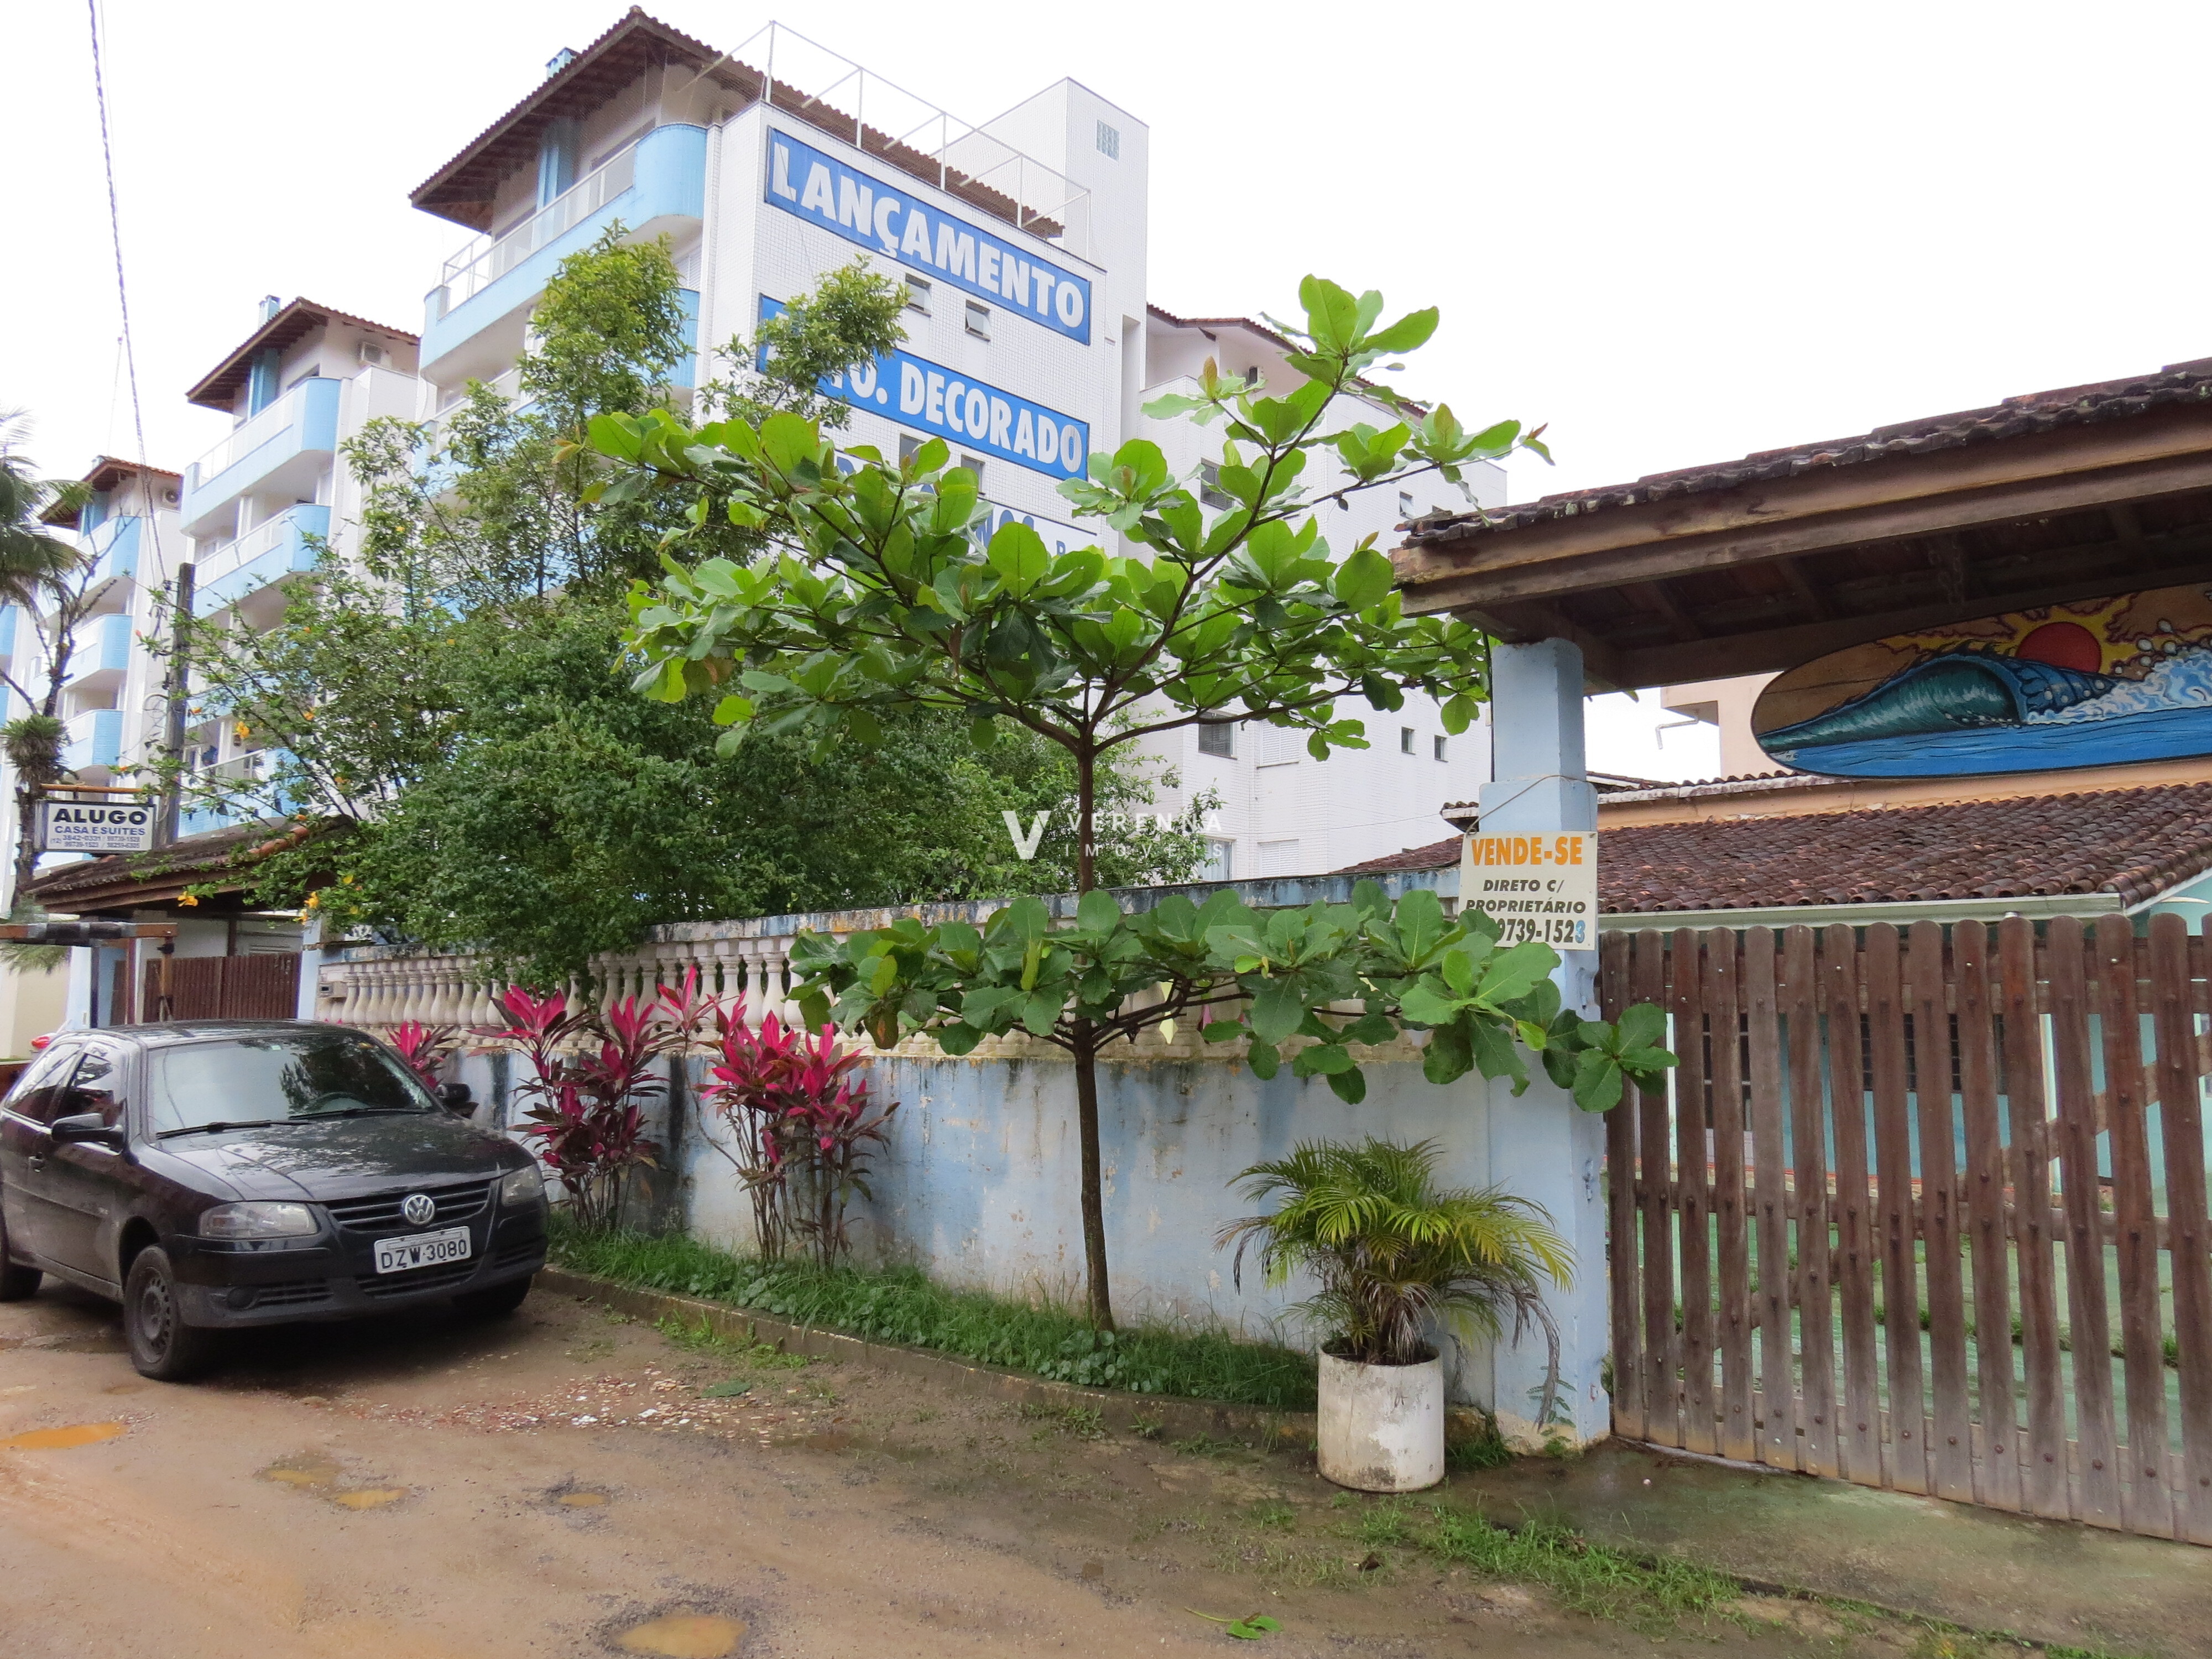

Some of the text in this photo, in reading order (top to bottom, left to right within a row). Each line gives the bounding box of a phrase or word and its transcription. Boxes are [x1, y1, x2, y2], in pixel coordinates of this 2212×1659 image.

[772, 141, 1084, 328] LANÇAMENTO
[899, 361, 1082, 473] DECORADO
[54, 808, 147, 825] ALUGO
[55, 826, 88, 834] CASA
[92, 826, 98, 834] E
[1471, 836, 1583, 866] VENDE-SE
[1483, 879, 1565, 893] DIRETO C/
[1466, 897, 1587, 914] PROPRIETÁRIO
